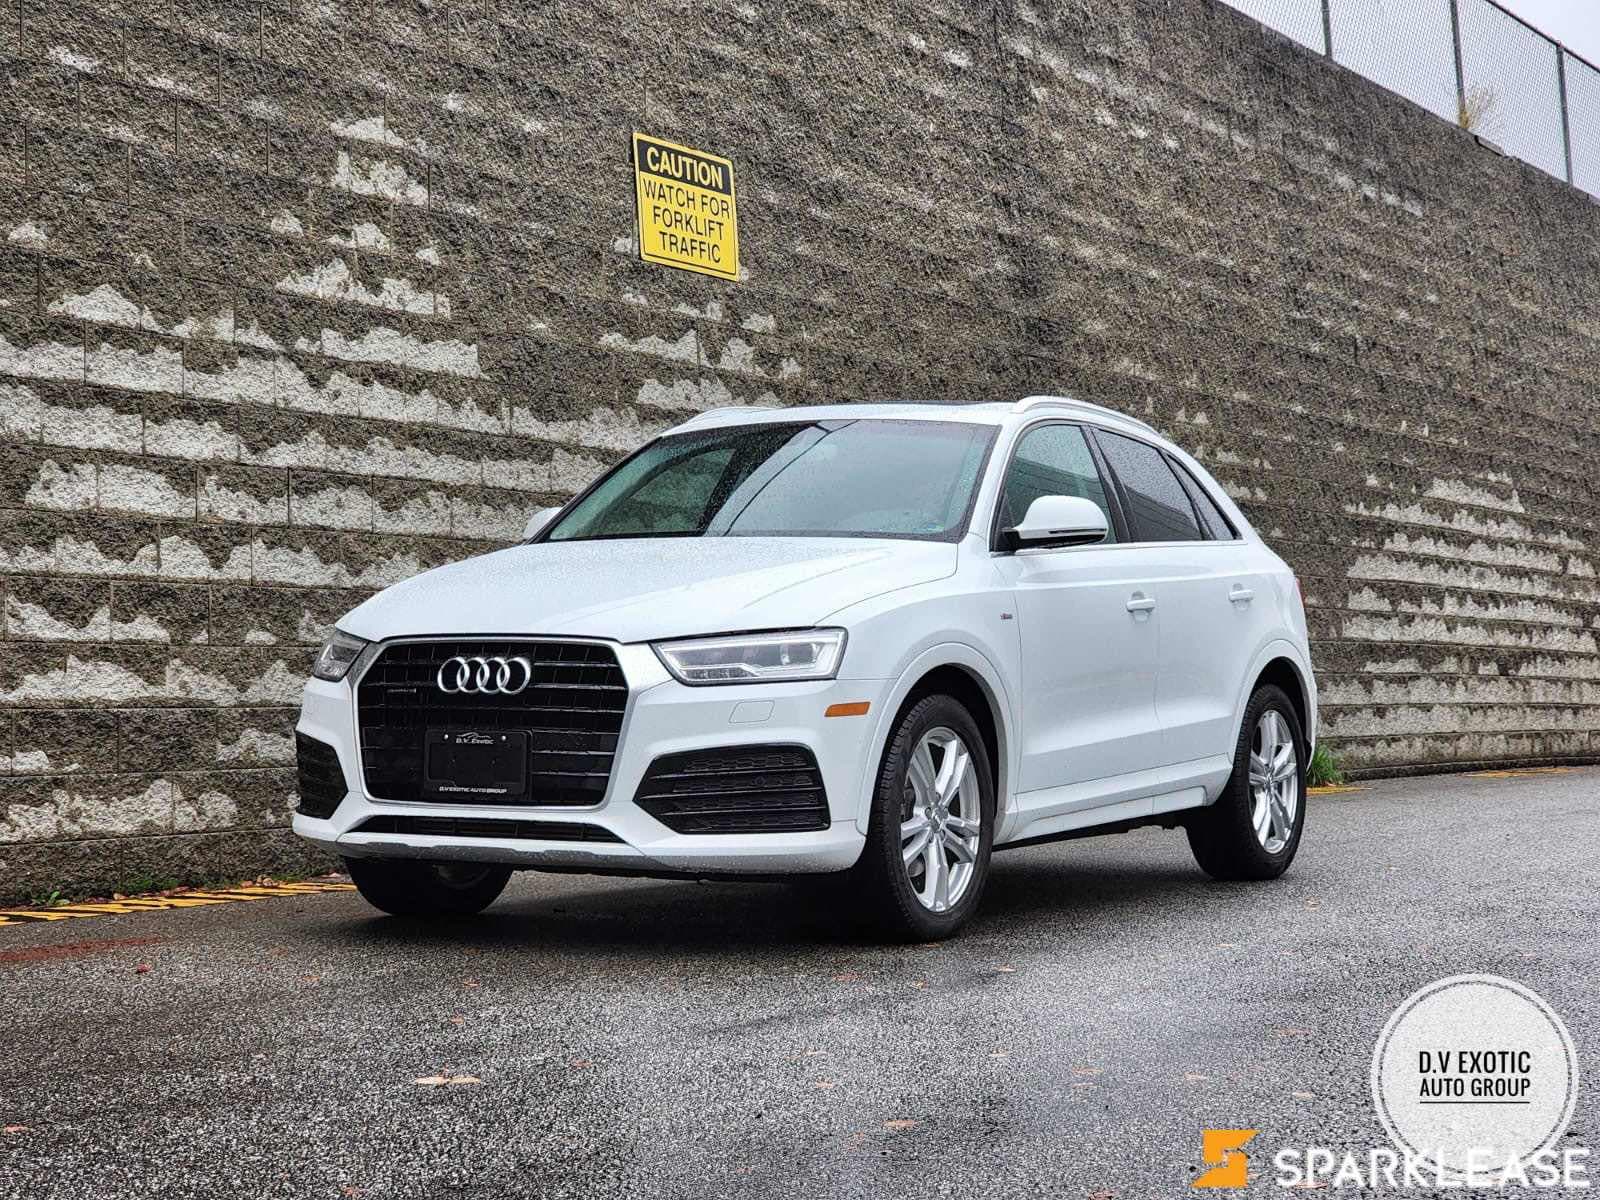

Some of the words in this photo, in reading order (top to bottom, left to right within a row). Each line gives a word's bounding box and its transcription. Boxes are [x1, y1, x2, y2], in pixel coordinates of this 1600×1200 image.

[647, 147, 723, 190] CAUTION
[643, 178, 696, 211] WATCH
[701, 194, 730, 219] FOR
[653, 206, 724, 241] FORKLIFT
[659, 231, 721, 263] TRAFFIC
